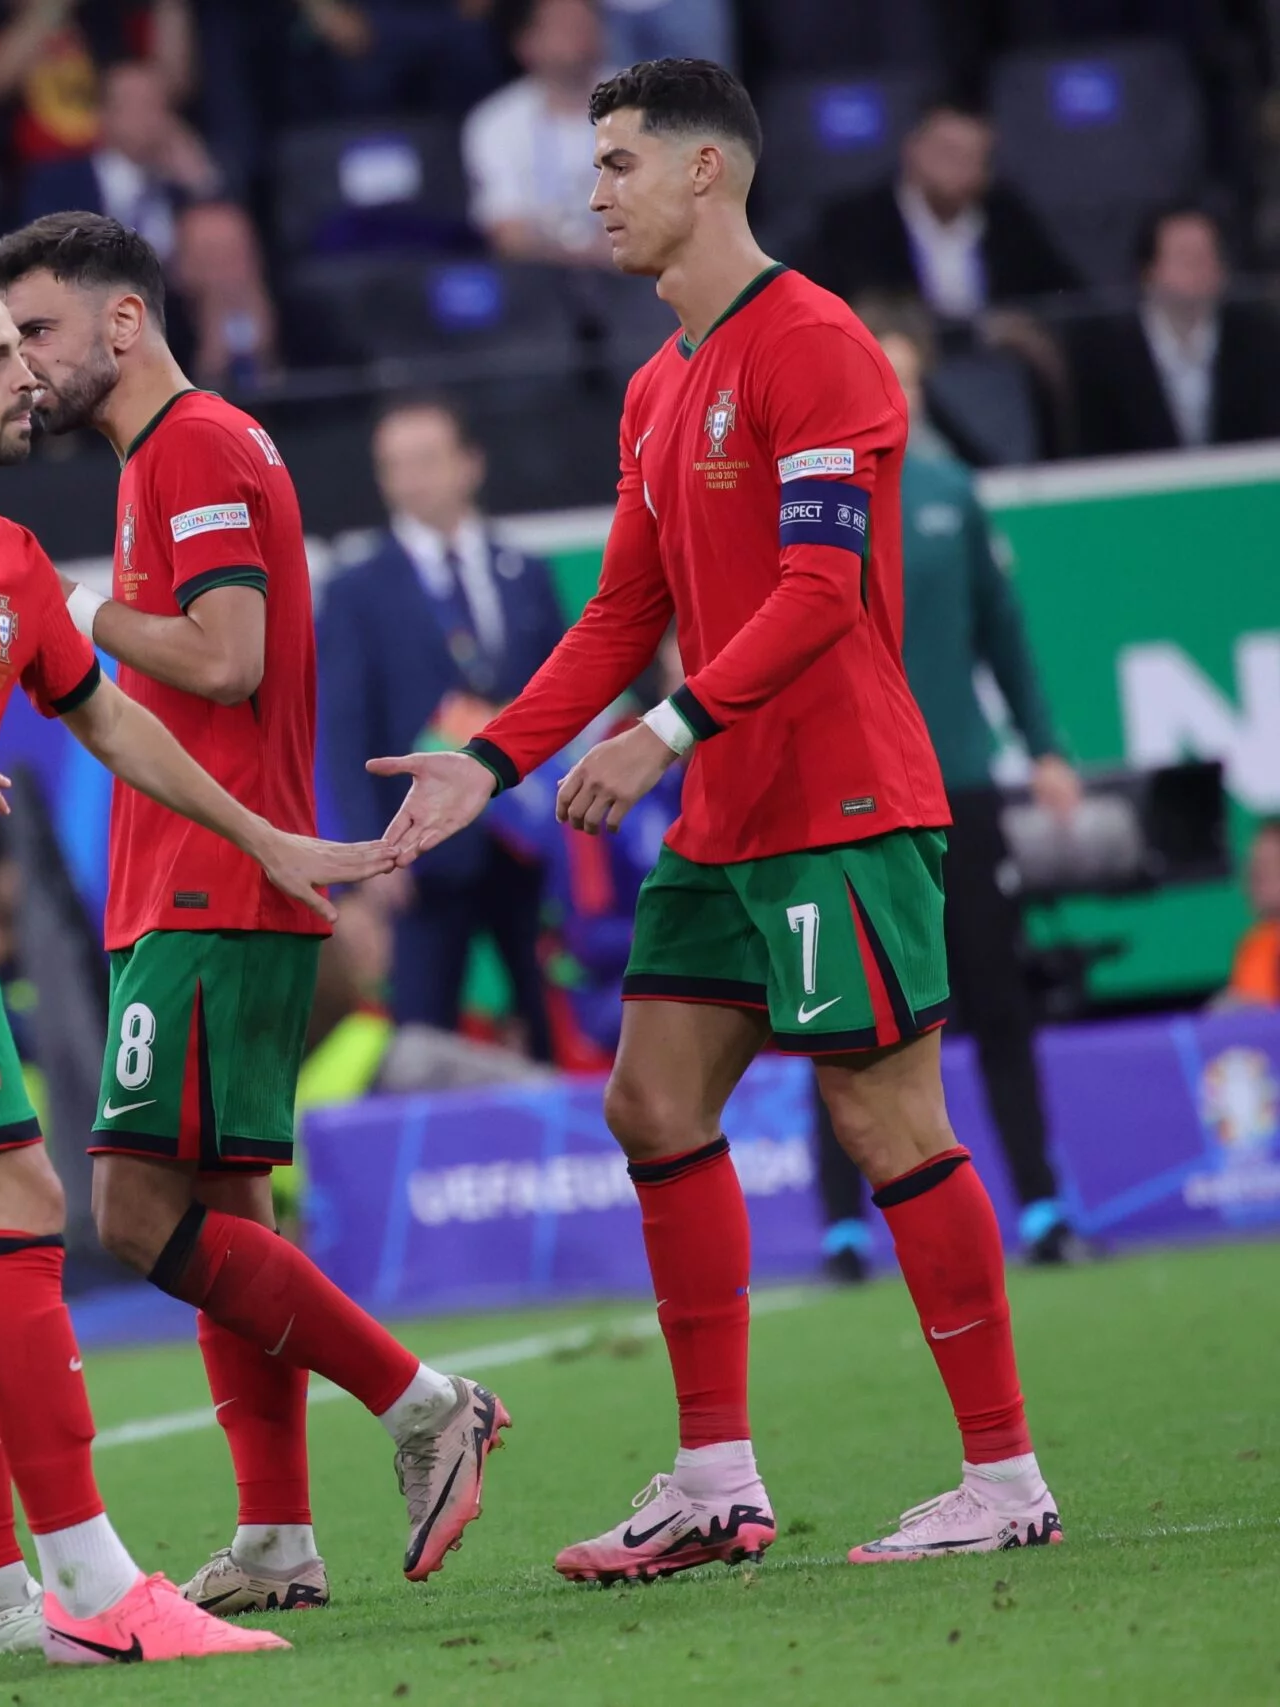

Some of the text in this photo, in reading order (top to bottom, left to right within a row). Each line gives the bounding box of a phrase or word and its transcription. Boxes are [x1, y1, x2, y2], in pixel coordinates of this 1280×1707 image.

[780, 456, 852, 473] FOUNDATION
[173, 510, 248, 532] FOUNDATION
[786, 902, 820, 995] 7
[116, 1002, 156, 1091] 8
